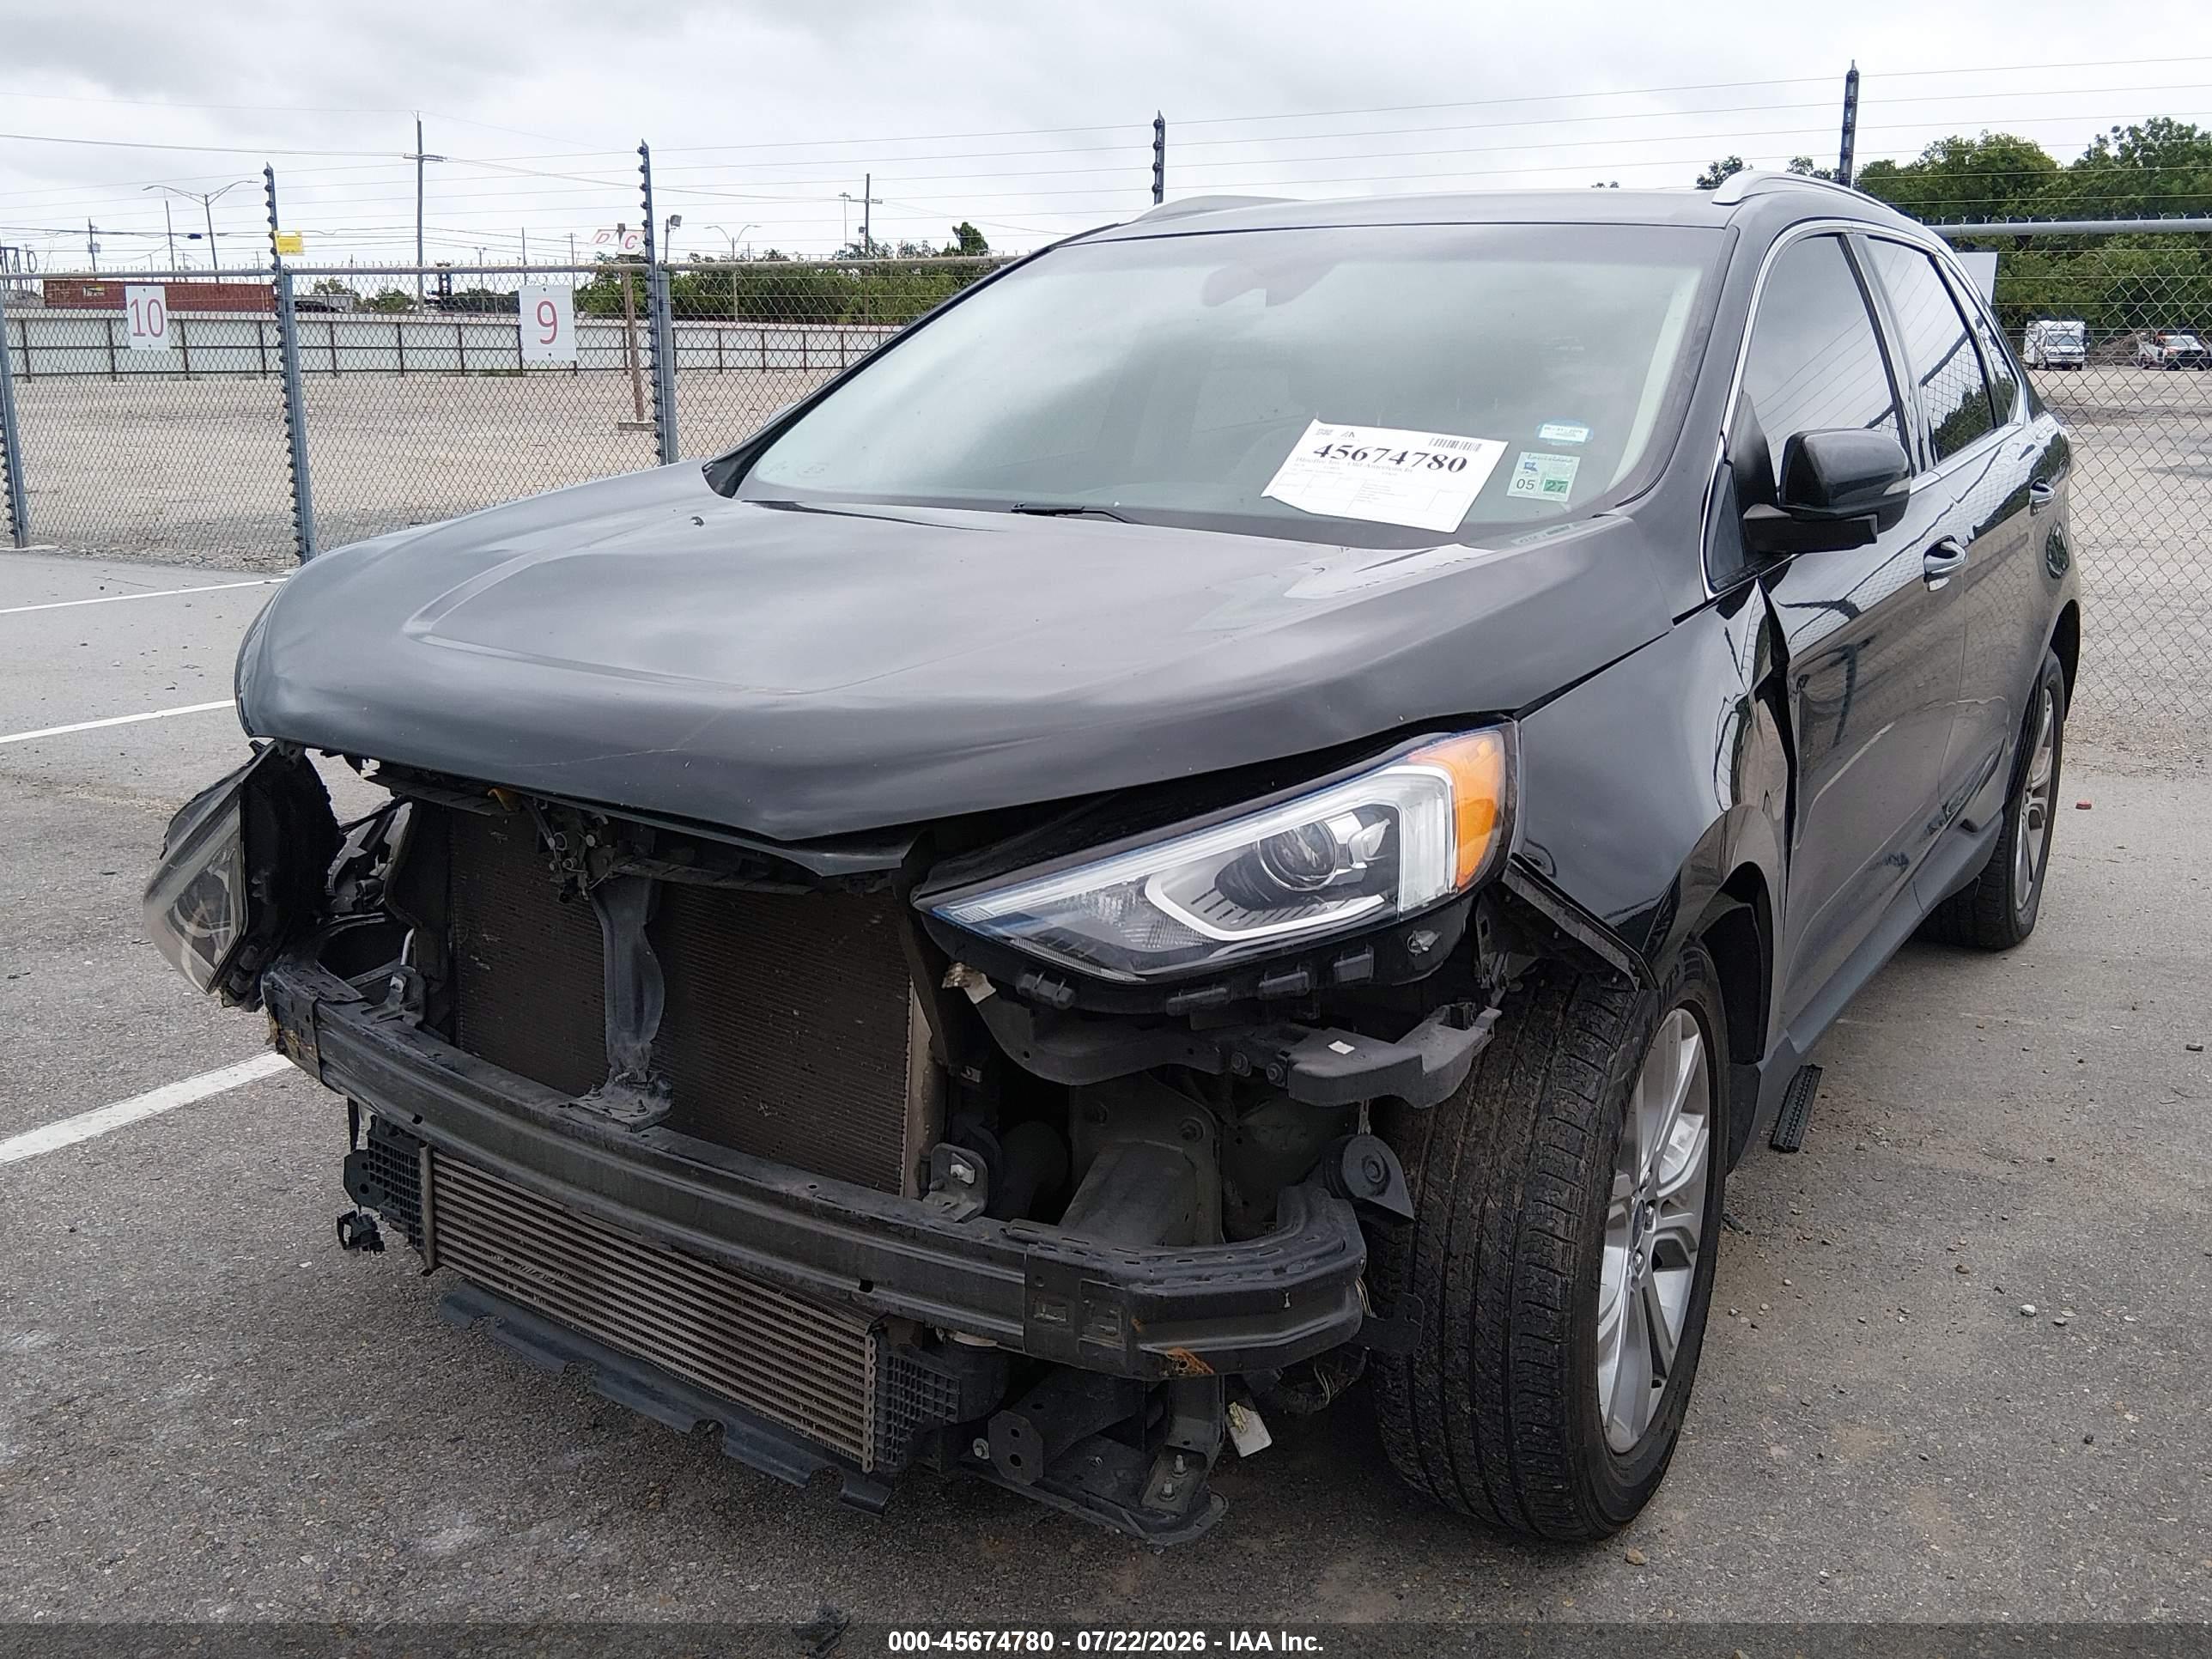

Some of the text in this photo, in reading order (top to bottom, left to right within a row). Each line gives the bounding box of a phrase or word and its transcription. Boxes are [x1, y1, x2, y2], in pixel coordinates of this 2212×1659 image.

[595, 233, 611, 245] D
[624, 234, 639, 251] C
[130, 298, 164, 337] 10
[537, 301, 558, 345] 9
[1313, 443, 1468, 473] 45674780
[1516, 478, 1535, 490] 05
[1545, 480, 1569, 493] 27
